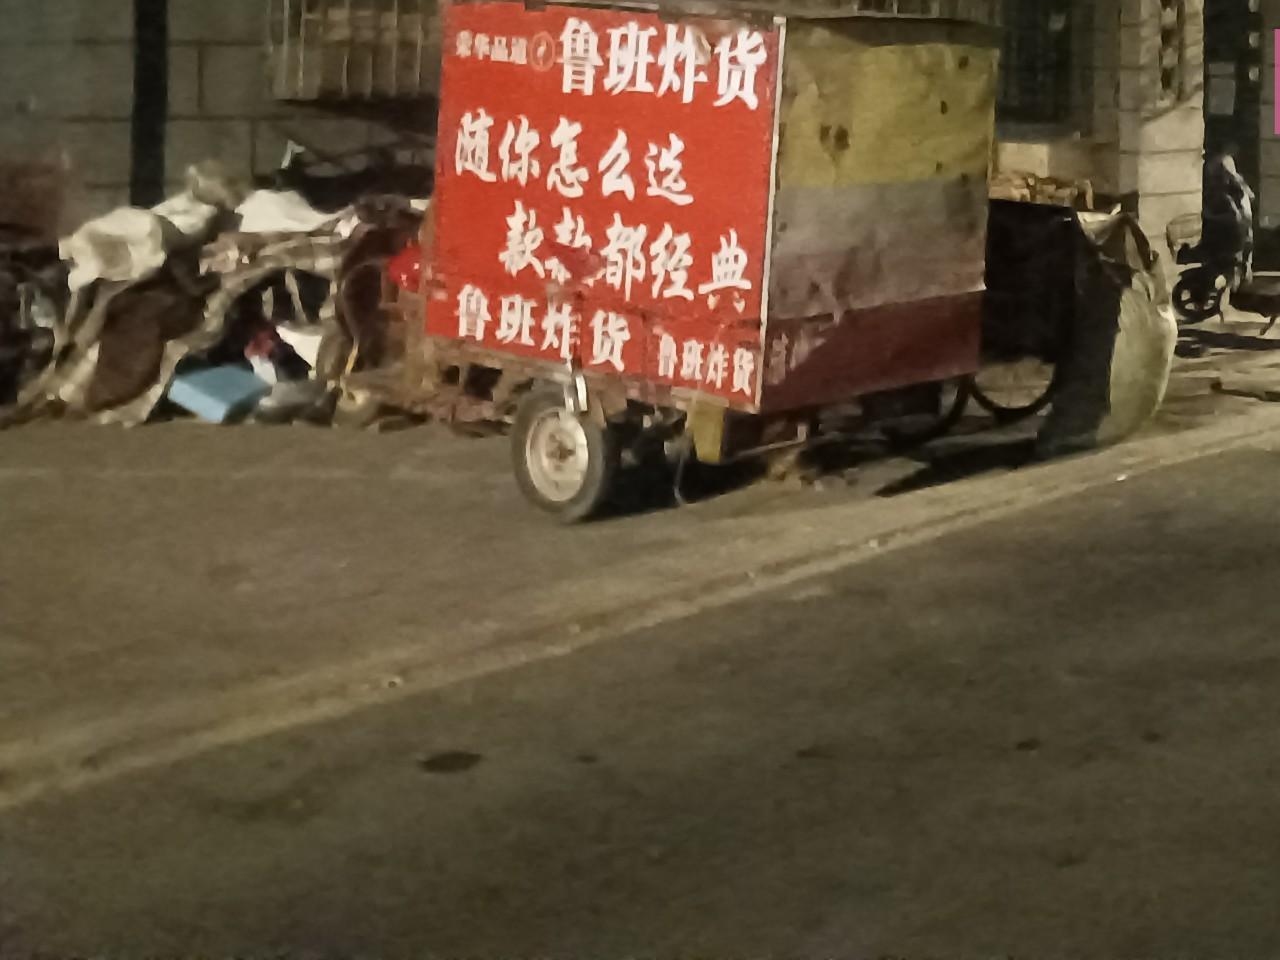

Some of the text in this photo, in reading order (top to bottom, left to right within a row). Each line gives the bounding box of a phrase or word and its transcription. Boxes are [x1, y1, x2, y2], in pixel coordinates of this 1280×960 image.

[560, 17, 766, 109] 鲁班炸货
[455, 109, 693, 205] 随你怎么选
[456, 284, 630, 371] 鲁班炸货
[658, 333, 754, 395] 鲁班炸货
